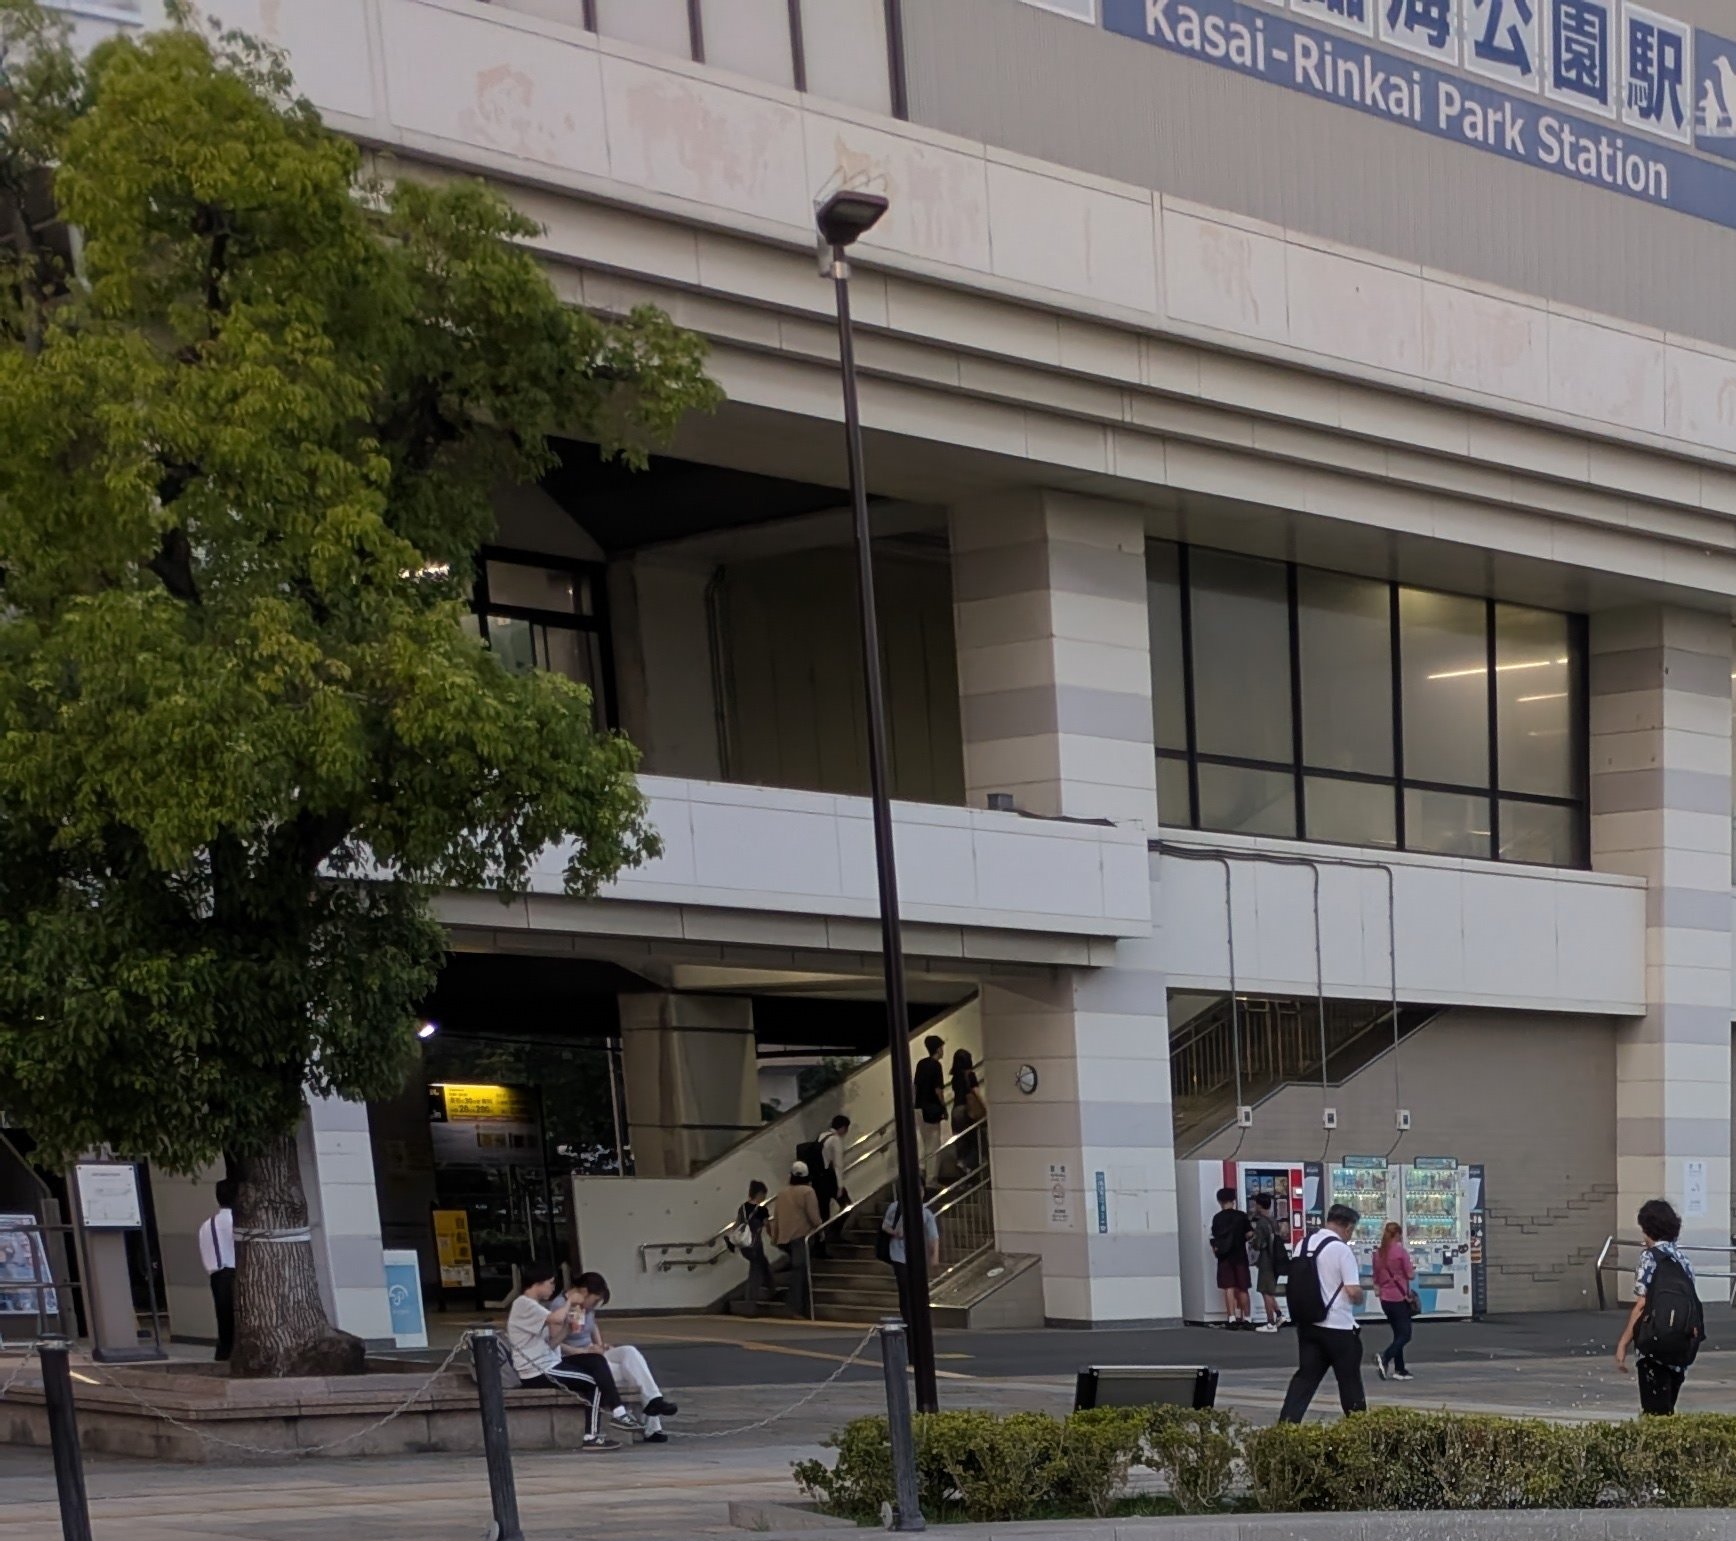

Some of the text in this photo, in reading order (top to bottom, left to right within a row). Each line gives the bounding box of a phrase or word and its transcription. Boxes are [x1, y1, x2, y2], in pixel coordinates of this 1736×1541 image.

[1145, 0, 1669, 200] Kasai-Rinkai Park Station
[1302, 0, 1685, 131] 海公園駅
